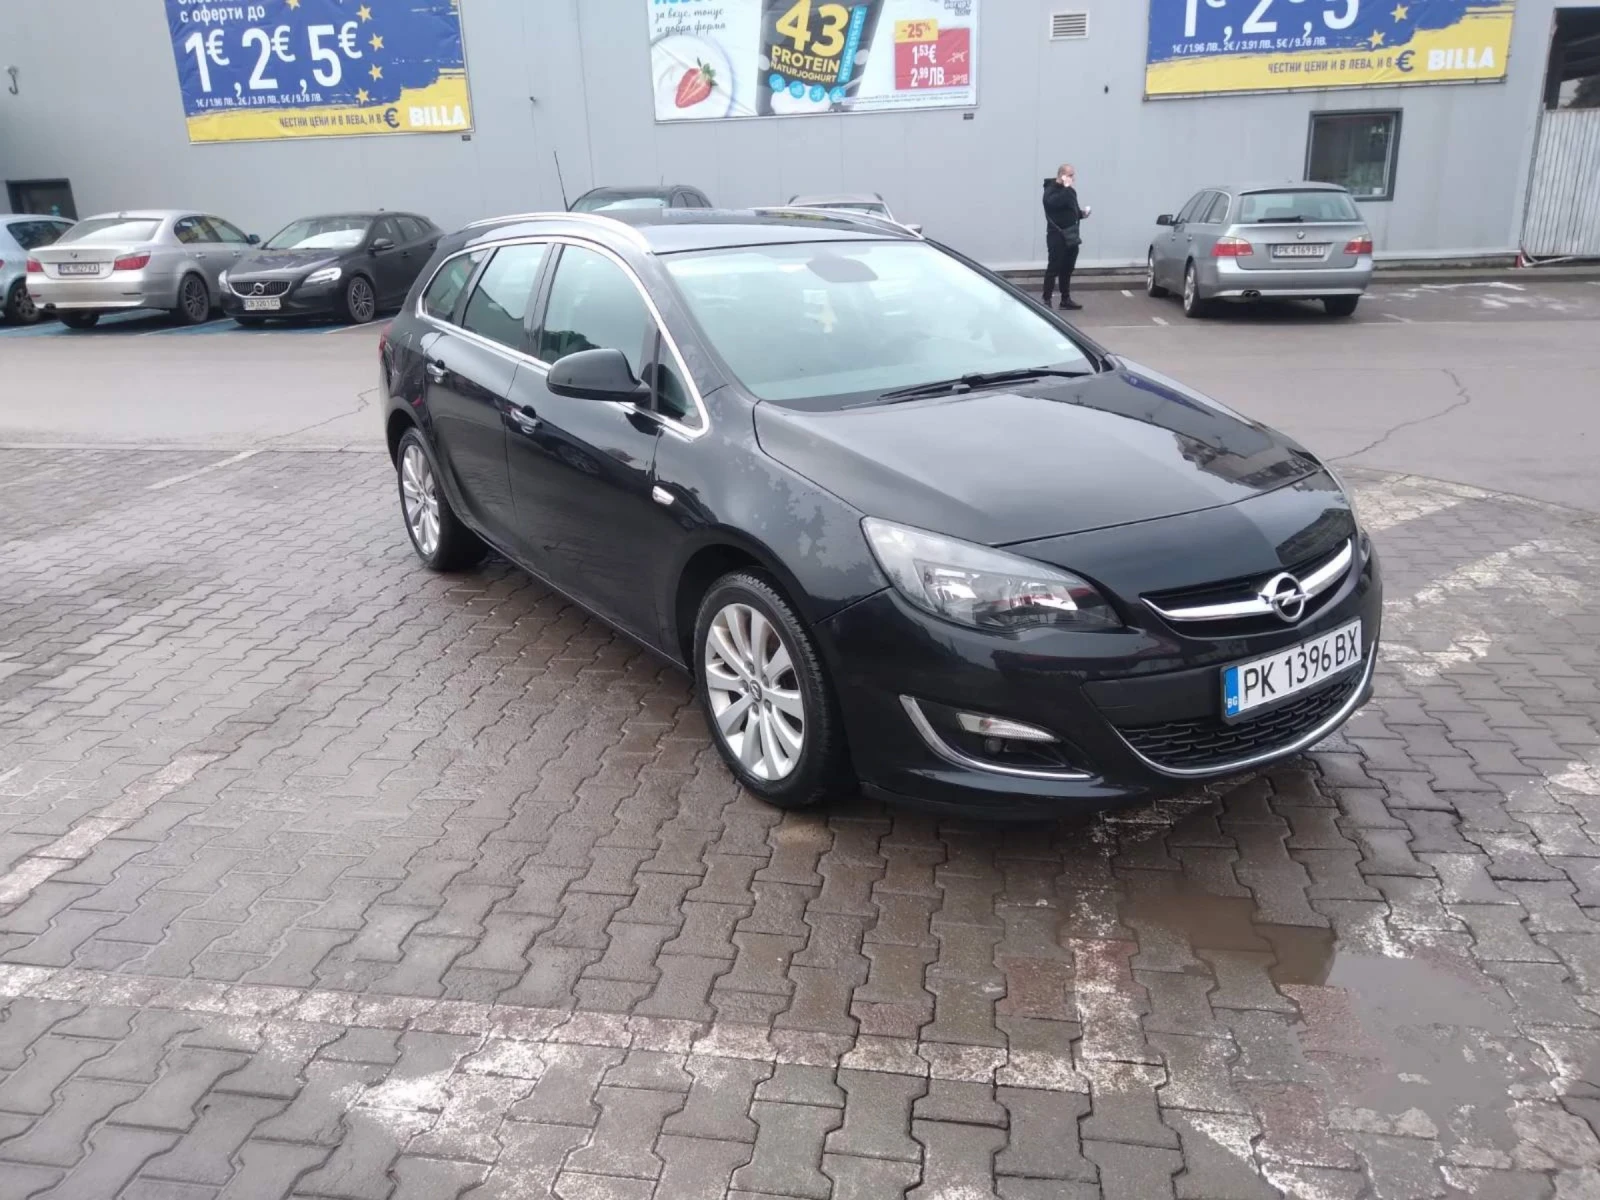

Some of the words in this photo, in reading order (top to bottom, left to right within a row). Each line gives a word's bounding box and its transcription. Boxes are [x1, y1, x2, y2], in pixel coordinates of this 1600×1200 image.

[181, 11, 188, 23] с
[193, 5, 243, 26] оферти
[247, 6, 265, 21] до
[776, 0, 849, 57] 43
[902, 22, 931, 39] -25%
[772, 45, 840, 72] PROTEIN
[1268, 62, 1301, 74] ЧЕСТНИ
[1304, 61, 1328, 73] ЦЕНИ
[1331, 60, 1337, 70] И
[1377, 58, 1383, 68] И
[1428, 47, 1495, 70] BILLA
[770, 60, 838, 82] NATURJOGHURT
[280, 116, 308, 128] ЧЕСТНИ
[310, 115, 329, 128] ЦЕНИ
[331, 116, 336, 126] И
[369, 113, 375, 123] И
[408, 105, 465, 127] BILLA
[1243, 661, 1276, 704] PK
[1285, 640, 1331, 688] 1396
[1335, 626, 1358, 667] BX
[1227, 696, 1238, 709] BG
